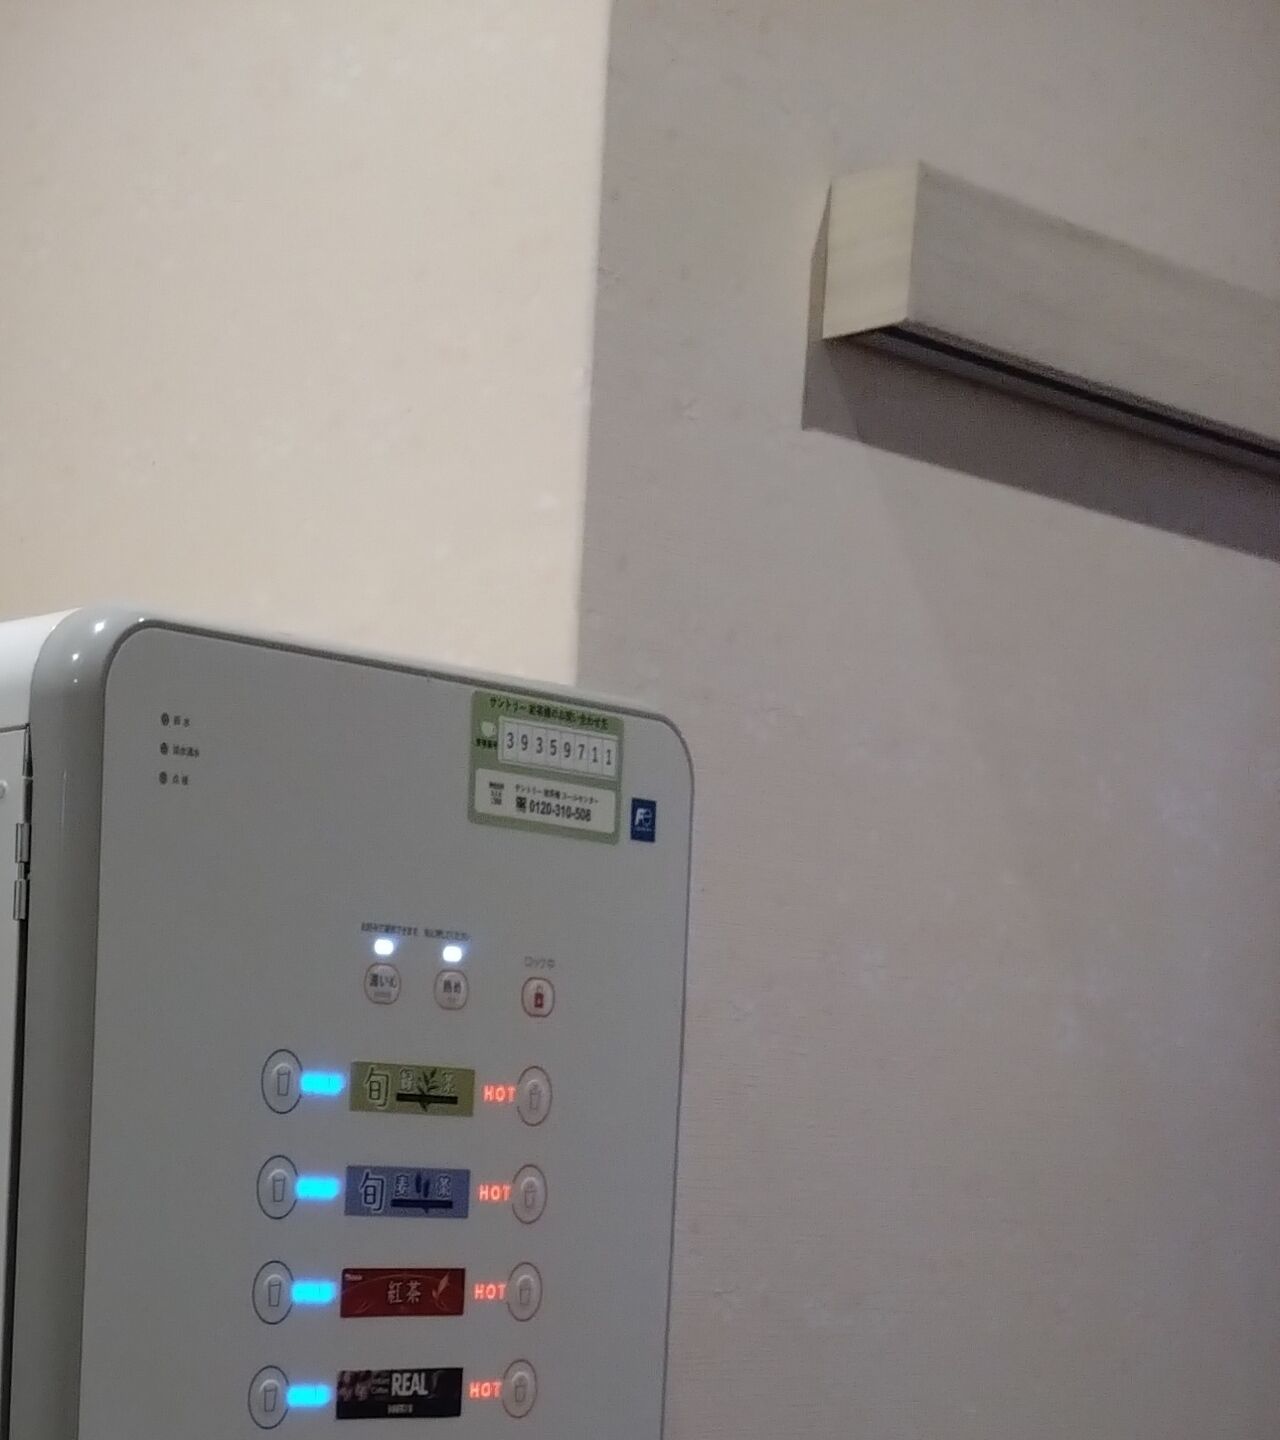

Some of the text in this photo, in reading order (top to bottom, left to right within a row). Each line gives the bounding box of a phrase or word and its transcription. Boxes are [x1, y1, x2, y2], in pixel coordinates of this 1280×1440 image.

[506, 732, 612, 766] 39359711
[364, 1066, 389, 1108] 旬
[483, 1085, 516, 1102] HOT
[359, 1171, 384, 1213] 旬
[479, 1185, 511, 1202] HOT
[387, 1280, 422, 1304] 紅茶
[474, 1283, 506, 1300] HOT
[391, 1372, 429, 1397] REAL
[469, 1382, 502, 1398] HOT
